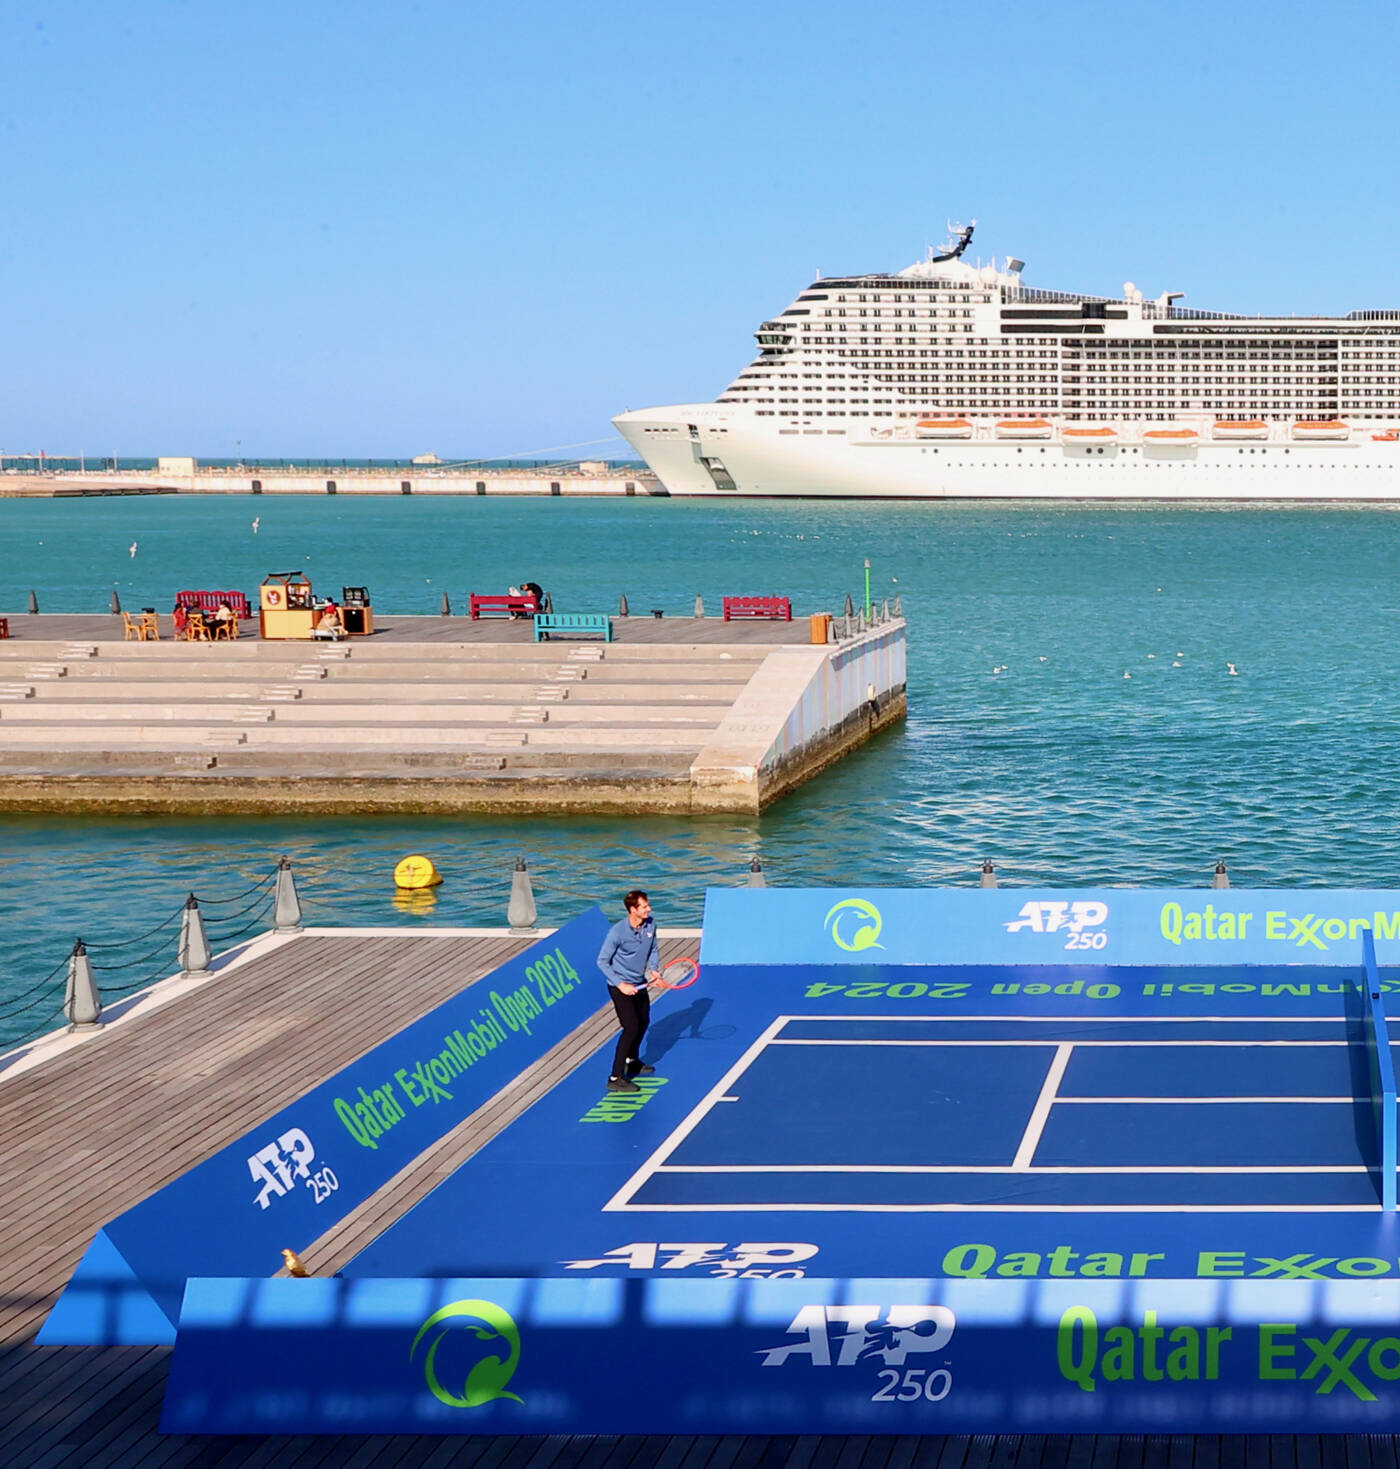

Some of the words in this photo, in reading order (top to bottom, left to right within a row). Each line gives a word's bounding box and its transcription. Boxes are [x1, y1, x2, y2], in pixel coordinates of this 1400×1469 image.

[1002, 902, 1109, 932] ATP
[1160, 902, 1254, 945] Qatar
[1063, 932, 1108, 950] 250
[804, 982, 972, 998] 2024
[991, 980, 1121, 999] Open
[334, 1083, 402, 1149] Qatar
[394, 1009, 507, 1106] ExxonMobil
[489, 986, 542, 1035] Open
[525, 948, 582, 1006] 2024
[246, 1127, 316, 1210] ATP
[305, 1167, 339, 1204] 250
[558, 1243, 819, 1269] ATP
[941, 1244, 1165, 1279] Qatar
[753, 1304, 957, 1367] ATP
[1057, 1306, 1233, 1392] Qatar
[871, 1369, 952, 1402] 250
